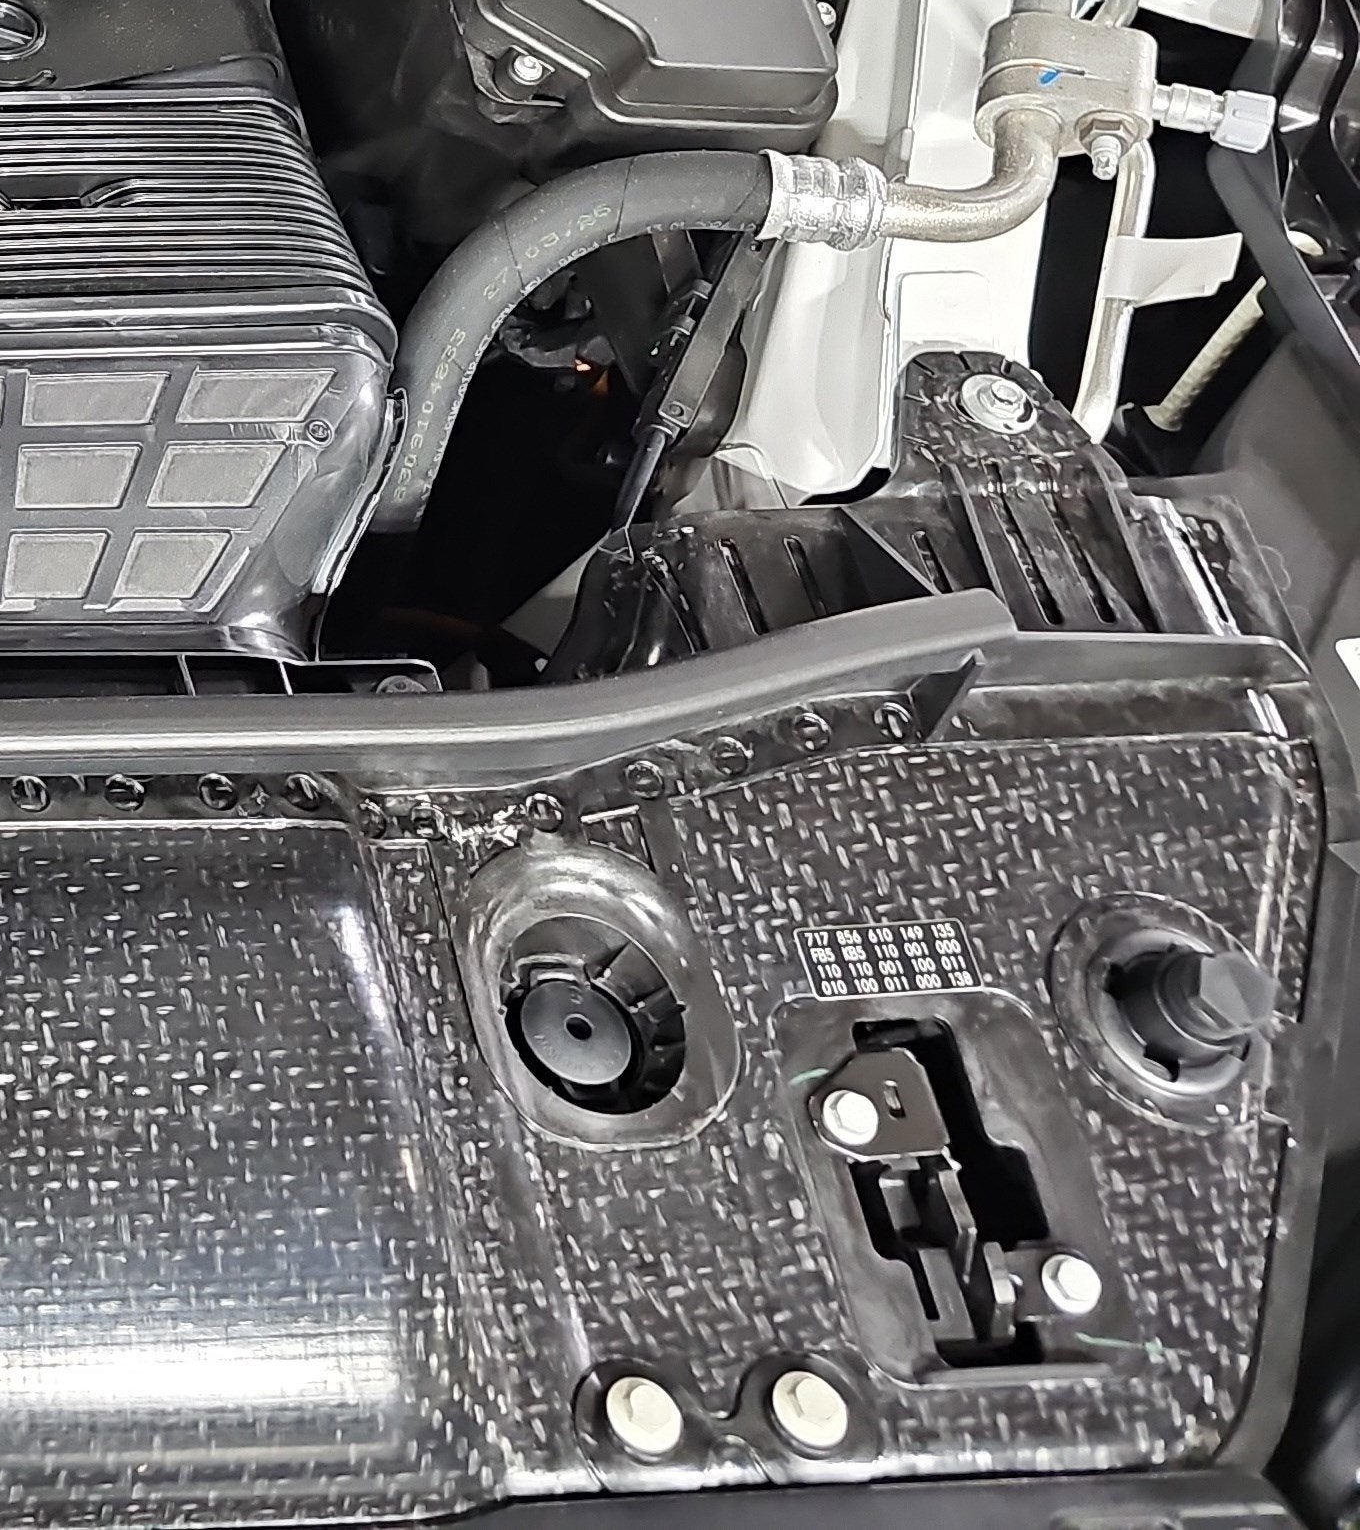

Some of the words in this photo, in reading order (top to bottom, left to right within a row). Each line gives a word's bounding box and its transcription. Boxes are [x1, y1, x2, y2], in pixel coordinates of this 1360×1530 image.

[804, 932, 829, 947] 717
[836, 930, 862, 945] 856
[868, 928, 893, 943] 610
[899, 926, 923, 940] 149
[931, 923, 955, 938] 135
[810, 948, 835, 964] FB5
[875, 944, 899, 958] 110
[904, 942, 928, 956] 001
[935, 939, 961, 954] 000
[817, 964, 841, 979] 110
[849, 962, 873, 977] 110
[879, 961, 904, 975] 001
[911, 958, 936, 972] 100
[941, 955, 966, 970] 011
[821, 980, 847, 995] 010
[854, 978, 879, 992] 100
[884, 976, 909, 991] 011
[916, 974, 942, 989] 000
[948, 971, 973, 986] 138
